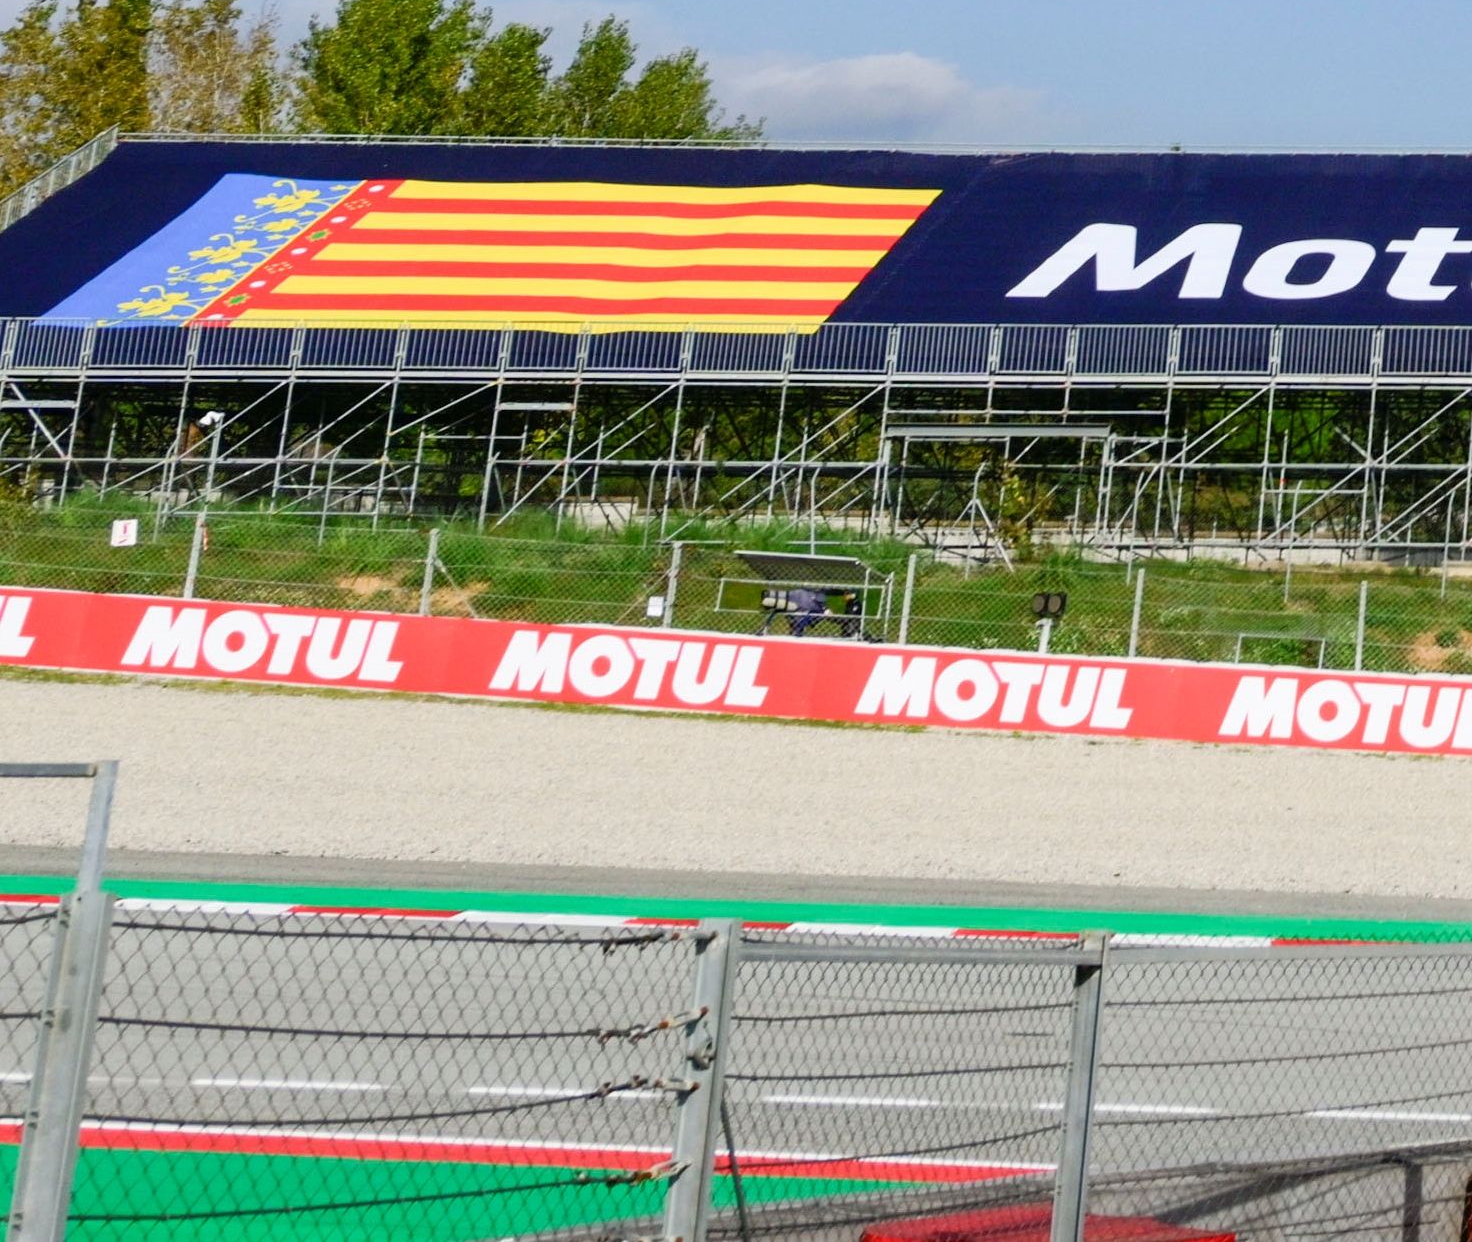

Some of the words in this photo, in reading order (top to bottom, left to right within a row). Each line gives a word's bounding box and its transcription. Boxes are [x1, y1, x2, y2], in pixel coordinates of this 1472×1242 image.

[121, 606, 402, 683] MOTUL
[489, 630, 769, 707] MOTUL
[854, 654, 1134, 730] MOTUL
